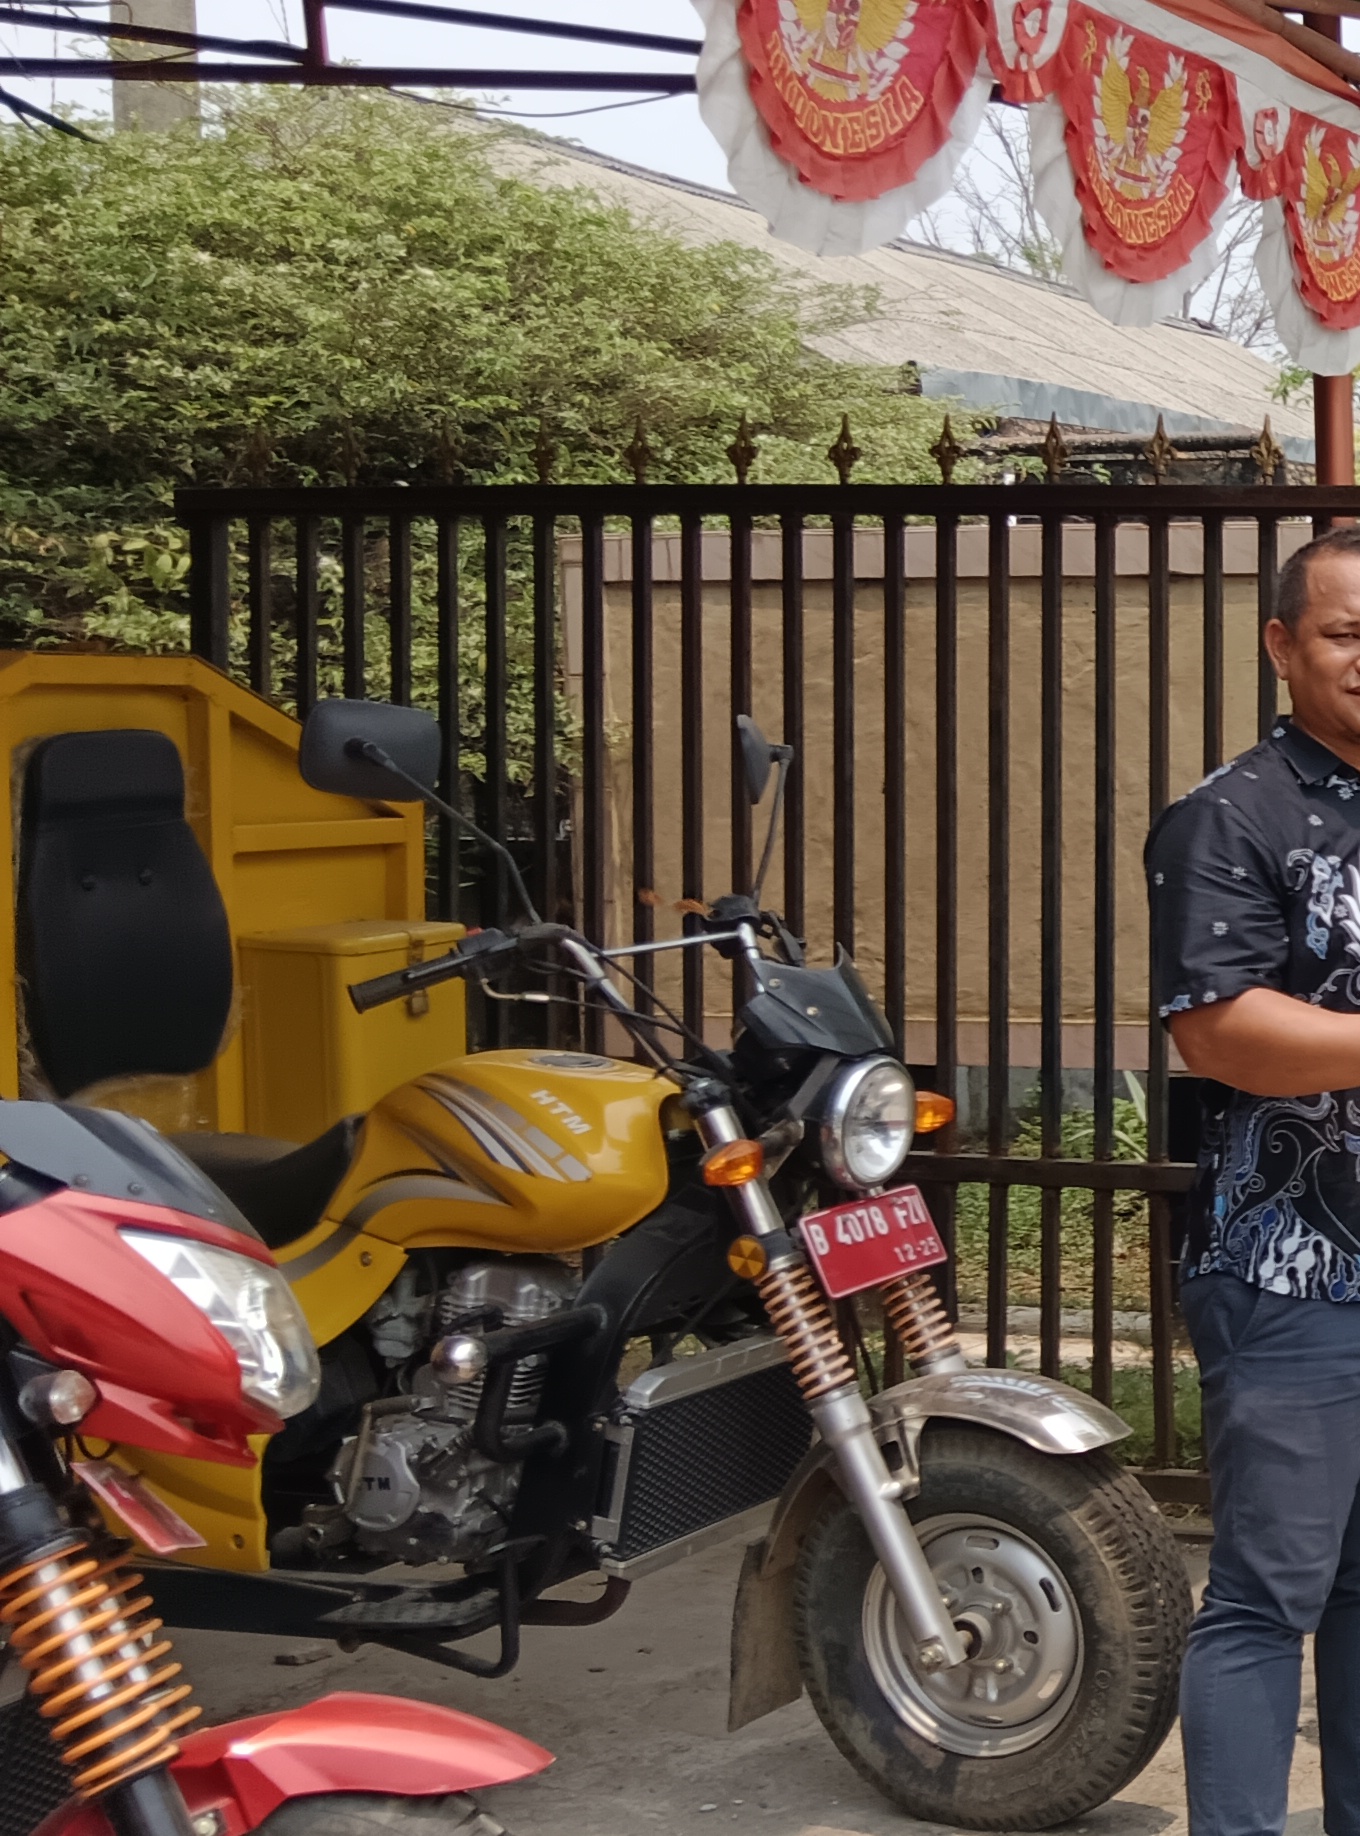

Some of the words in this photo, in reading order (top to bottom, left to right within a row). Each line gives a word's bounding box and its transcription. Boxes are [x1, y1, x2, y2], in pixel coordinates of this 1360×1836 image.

[766, 30, 924, 154] INDONESIA
[530, 1089, 593, 1135] HTM
[809, 1224, 830, 1256] B
[835, 1206, 889, 1245] 4078
